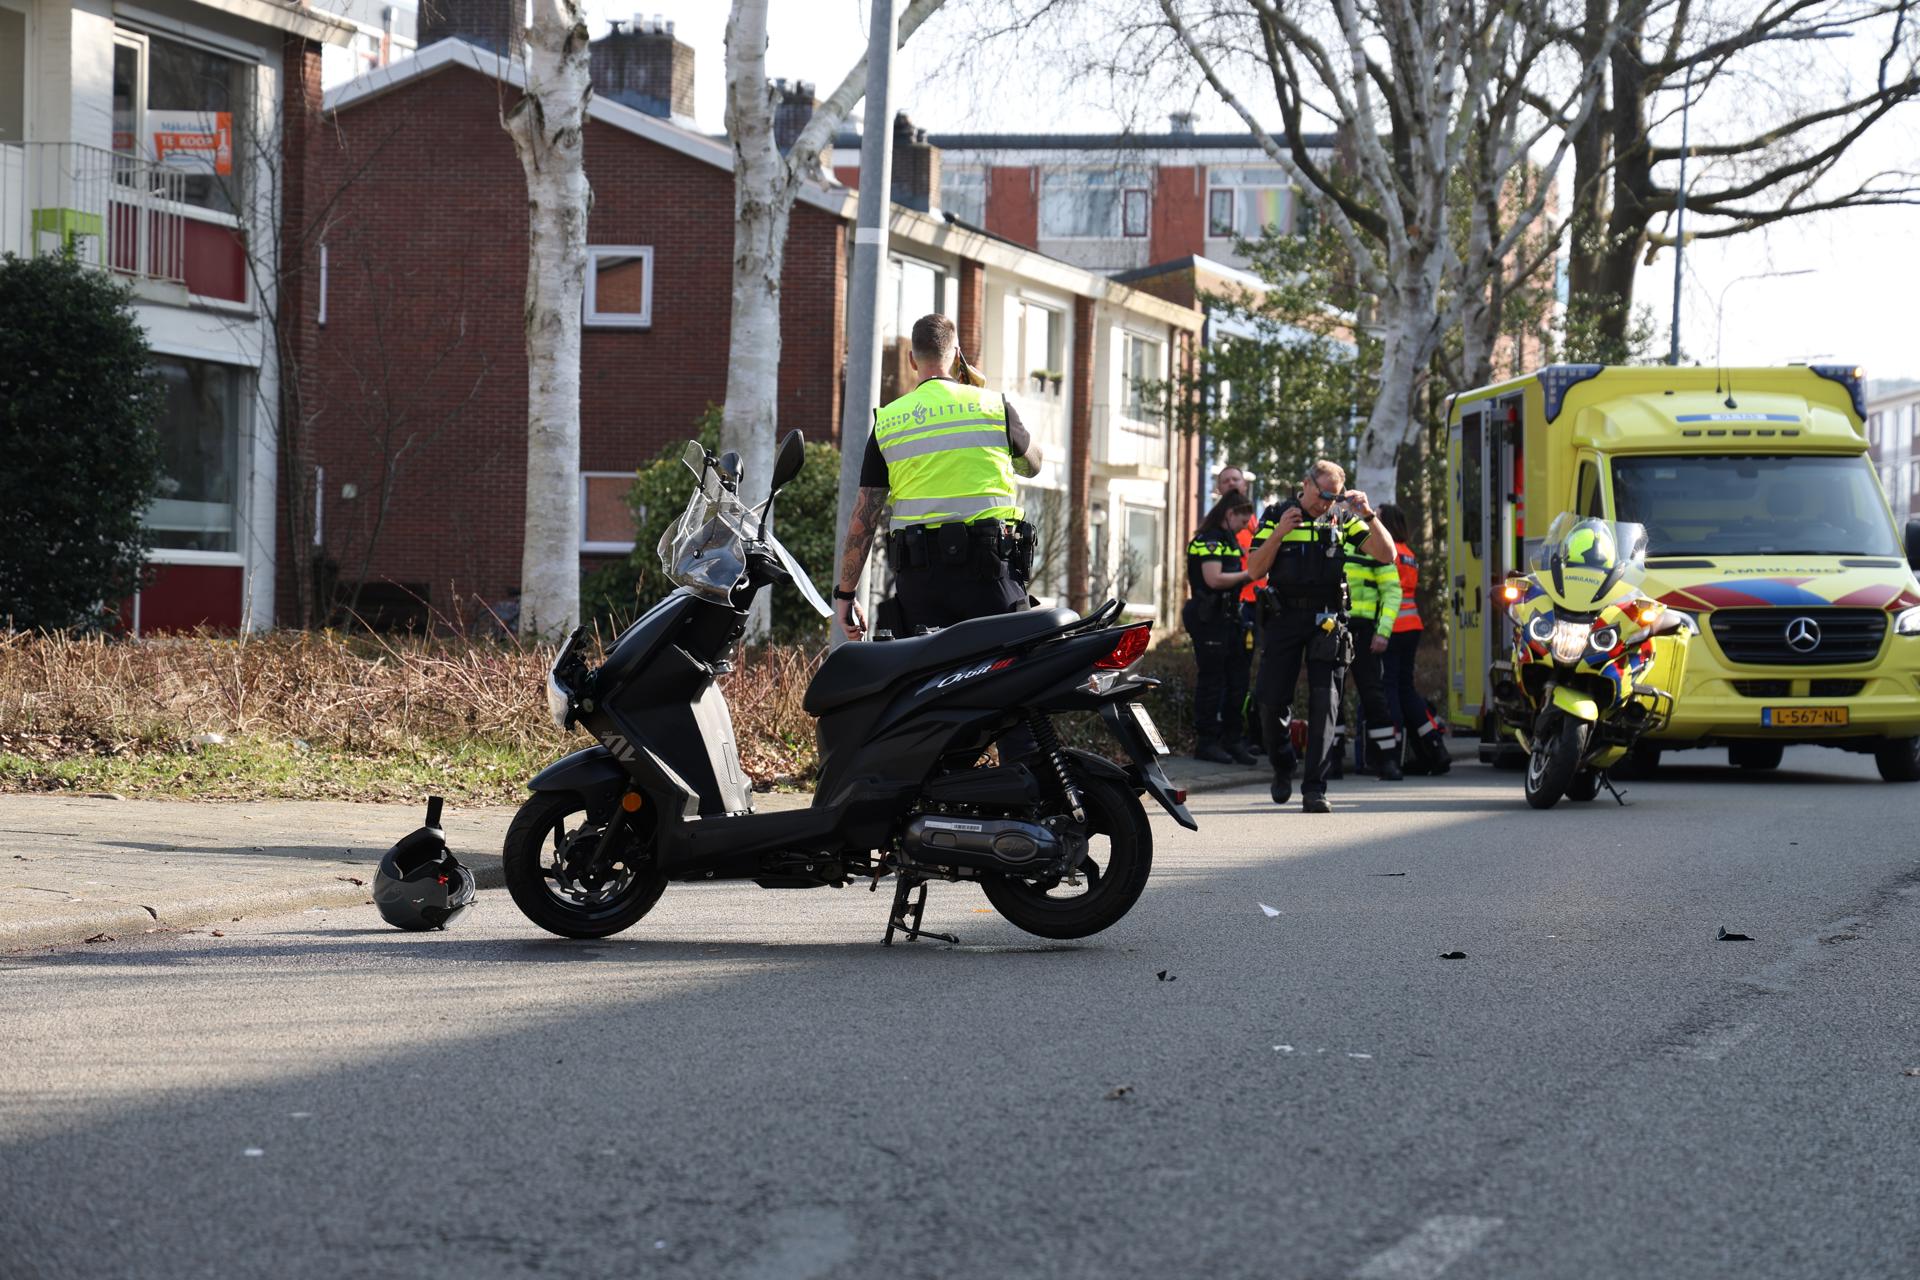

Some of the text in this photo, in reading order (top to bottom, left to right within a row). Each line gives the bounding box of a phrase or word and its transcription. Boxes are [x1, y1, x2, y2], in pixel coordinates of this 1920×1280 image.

[161, 134, 214, 145] TE KOOP
[902, 402, 974, 425] POLITIE
[1564, 575, 1601, 585] AMBULANCE
[937, 664, 992, 688] Orbit
[1776, 710, 1842, 724] L-567-NL
